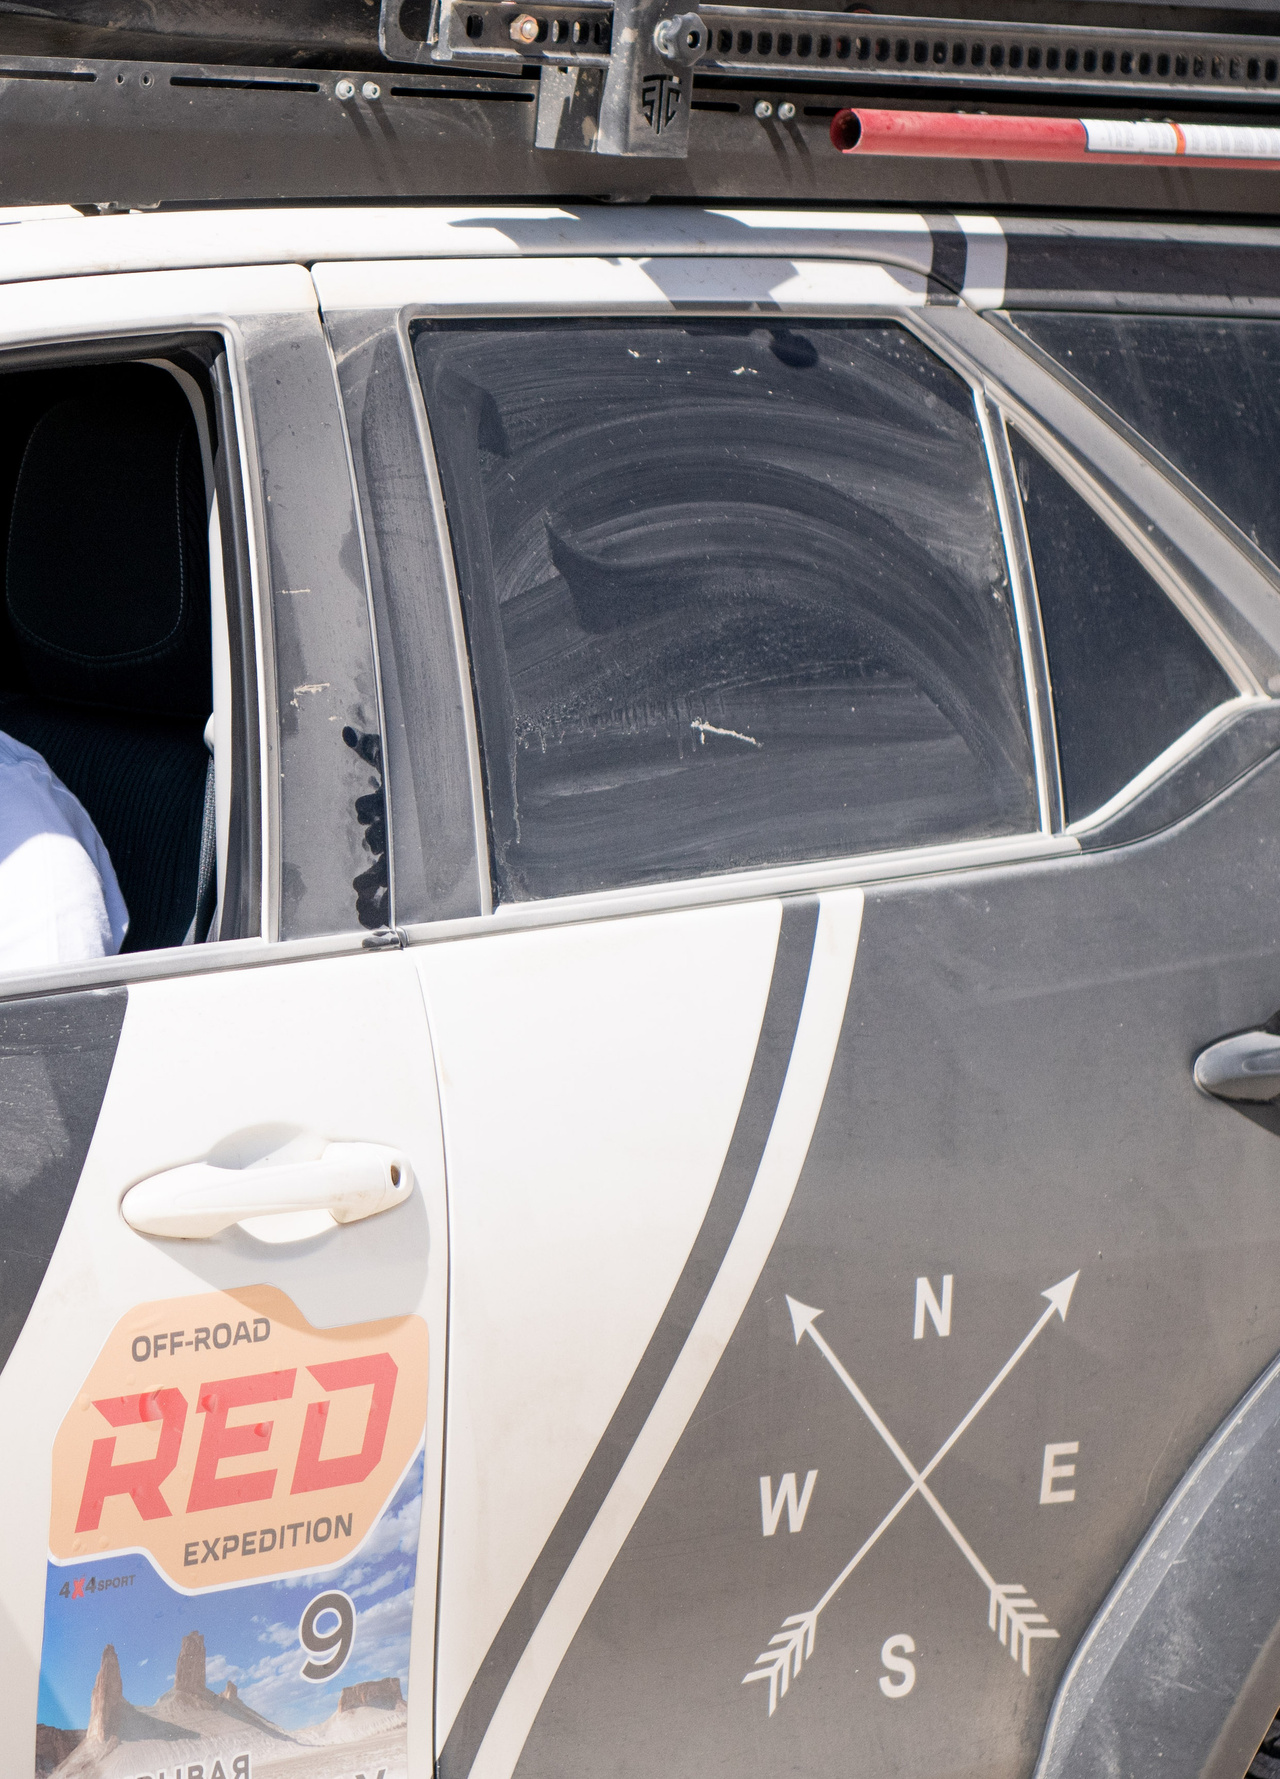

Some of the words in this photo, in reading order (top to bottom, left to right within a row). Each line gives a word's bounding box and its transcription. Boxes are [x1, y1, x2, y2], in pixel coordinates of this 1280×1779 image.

[913, 1274, 953, 1339] N
[131, 1317, 271, 1363] OFF-ROAD
[74, 1352, 399, 1534] RED
[1039, 1441, 1079, 1504] E
[759, 1469, 818, 1537] W
[183, 1512, 353, 1567] EXPEDITION
[301, 1593, 354, 1681] 9
[879, 1634, 916, 1698] S
